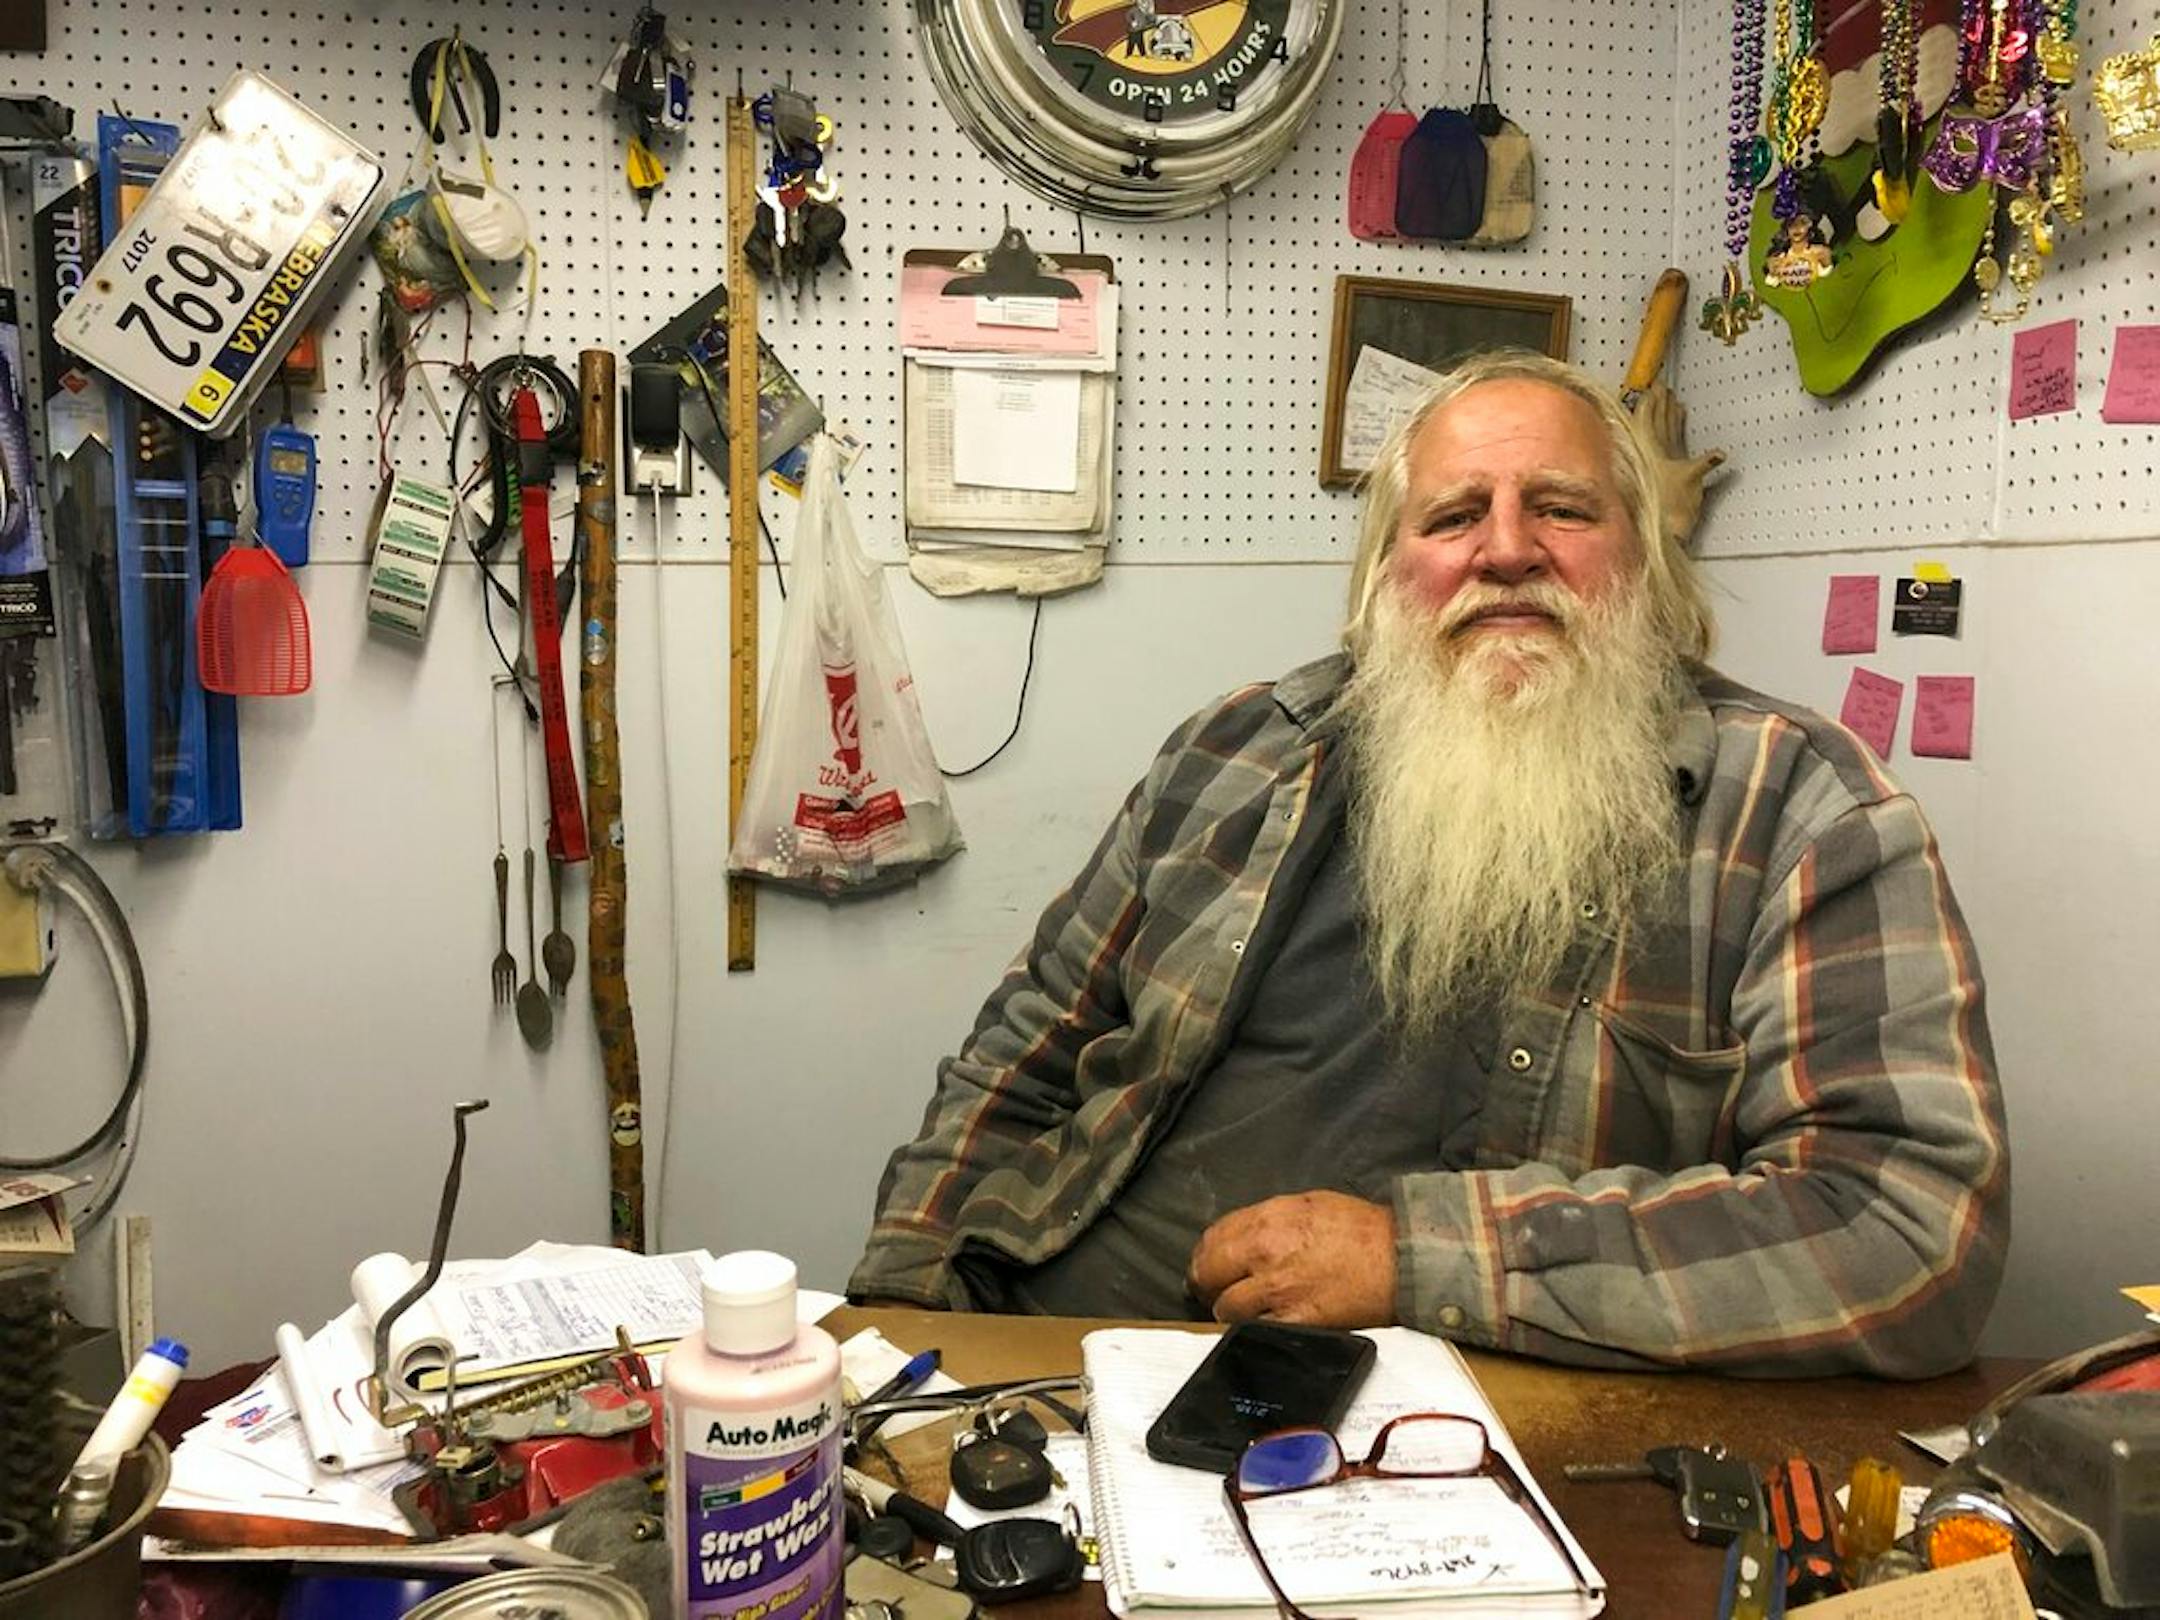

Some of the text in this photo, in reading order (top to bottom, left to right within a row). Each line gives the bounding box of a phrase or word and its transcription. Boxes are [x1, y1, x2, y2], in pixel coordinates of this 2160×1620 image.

[1072, 63, 1095, 92] 7
[1108, 20, 1271, 105] OPEN 24 HOURS
[40, 166, 59, 180] 22
[52, 206, 84, 310] TRICO
[122, 227, 156, 274] 2017
[706, 1402, 832, 1446] Auto Magic
[701, 1507, 831, 1586] Wet Wax
